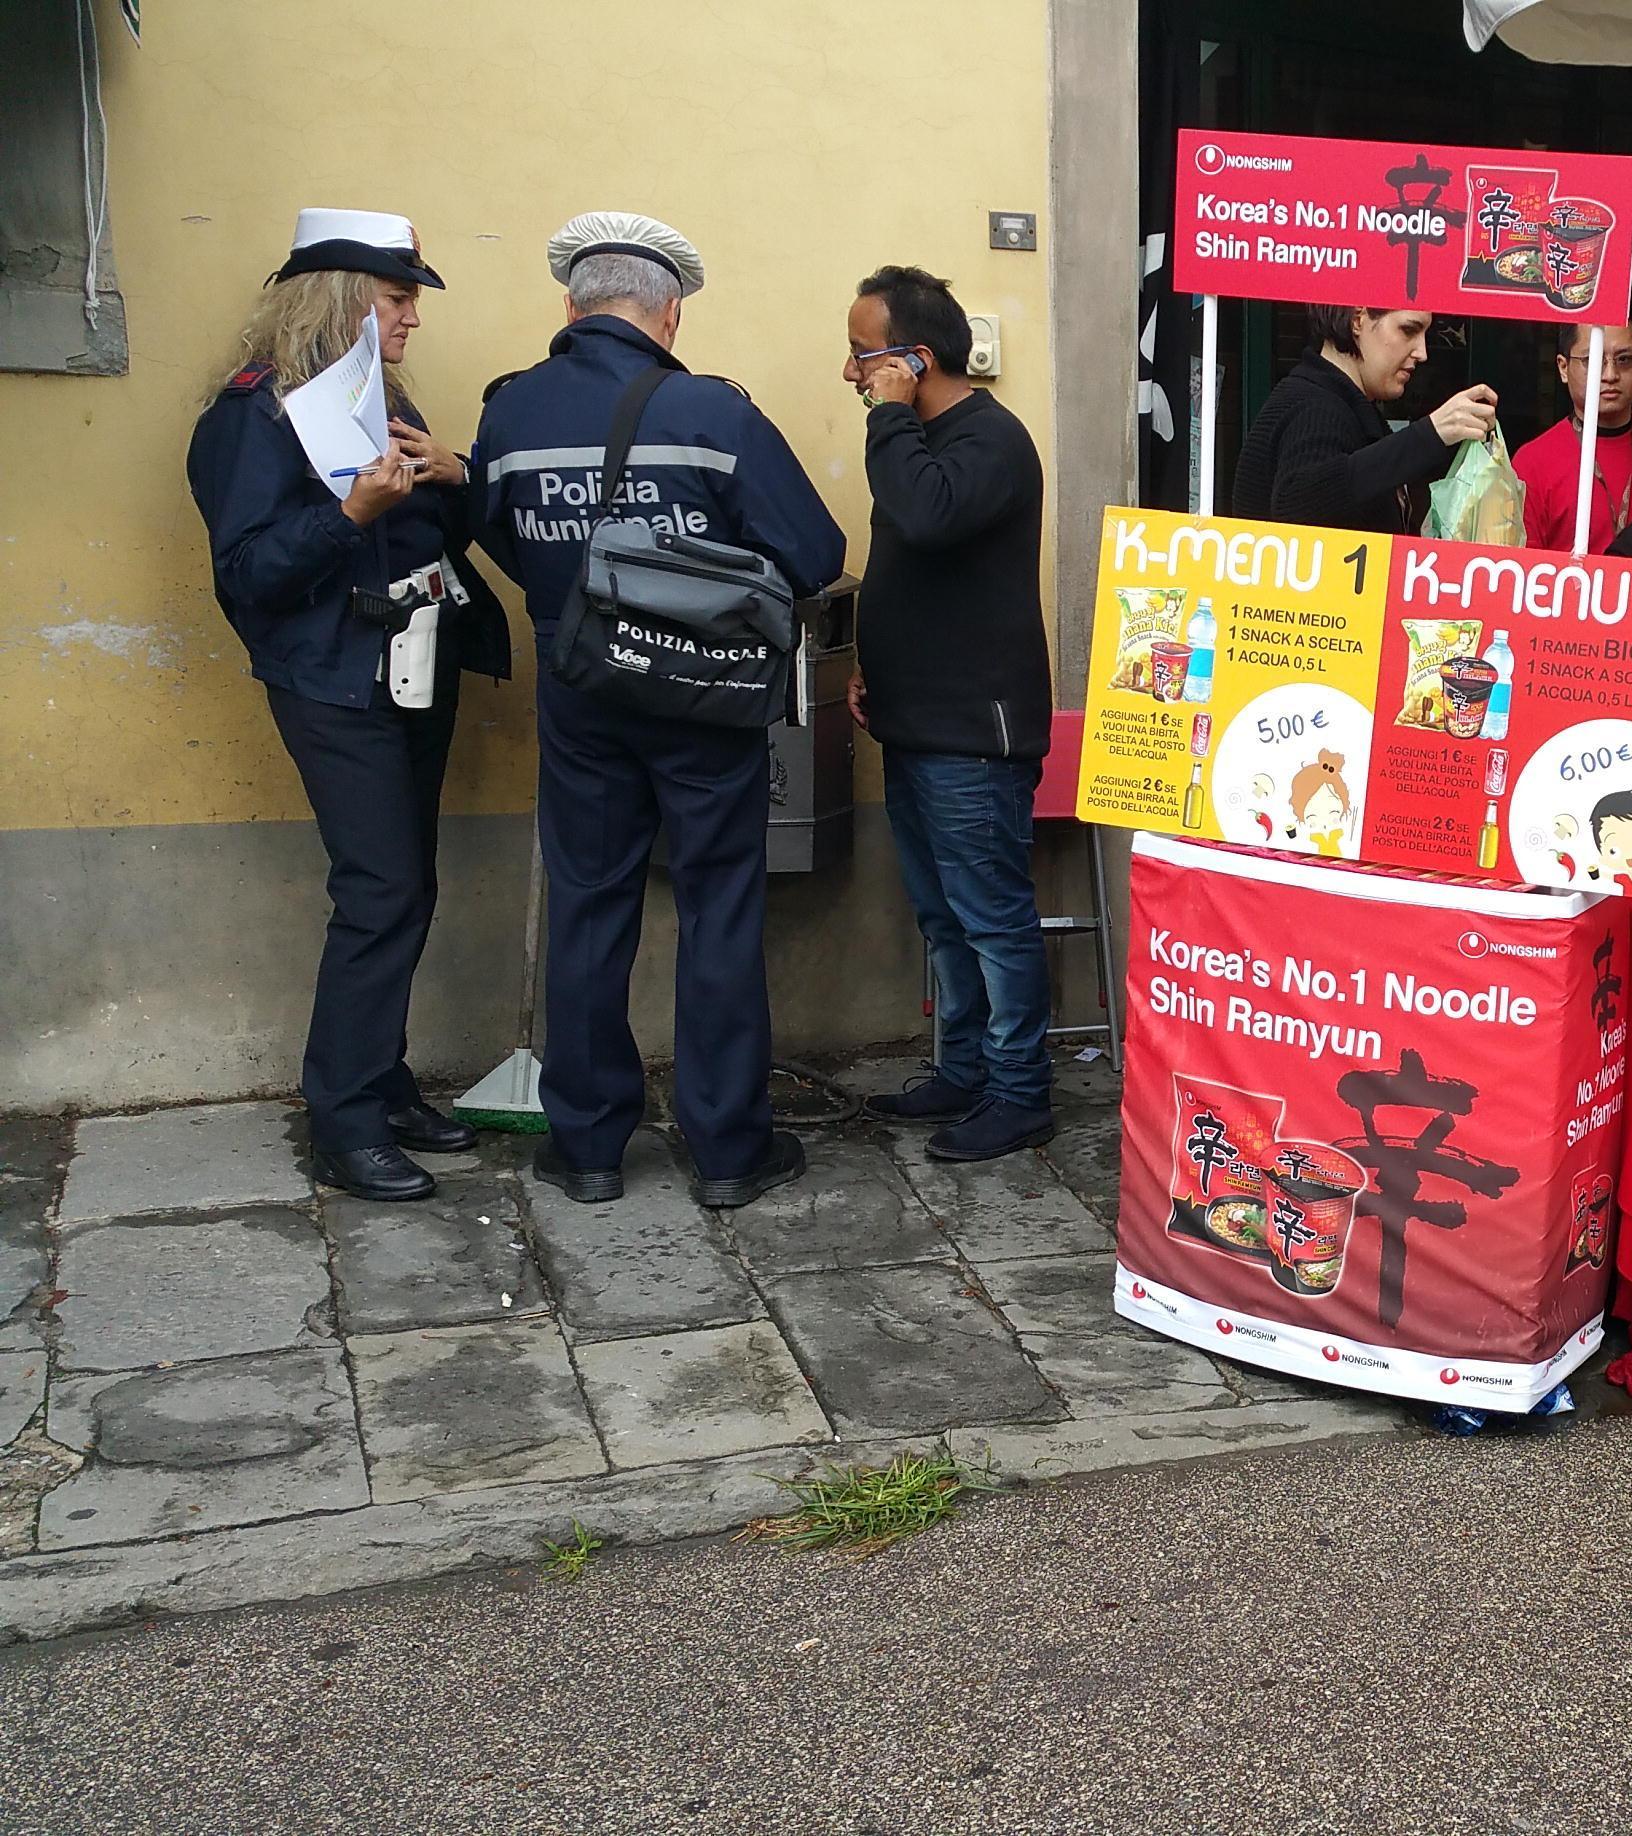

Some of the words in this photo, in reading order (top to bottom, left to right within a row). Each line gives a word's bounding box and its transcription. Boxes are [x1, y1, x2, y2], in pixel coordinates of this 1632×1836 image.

[1226, 153, 1292, 172] NONGSHIM
[1196, 193, 1289, 224] Korea's
[1295, 203, 1348, 231] No.1
[1357, 205, 1446, 237] Noodle
[1195, 235, 1250, 260] Shin
[1256, 237, 1358, 273] Ramyun
[539, 471, 659, 505] Polizia
[1114, 519, 1324, 592] K-MENU
[1343, 543, 1368, 595] 1
[1403, 550, 1631, 625] K-MENU
[1230, 604, 1238, 618] 1
[1243, 606, 1296, 625] RAMEN
[1298, 612, 1347, 630] MEDIO
[617, 621, 696, 654] POLIZIA
[1228, 626, 1237, 640] 1
[1241, 628, 1291, 646] SNACK
[1295, 634, 1305, 648] A
[1307, 634, 1364, 654] SCELTA
[1529, 638, 1538, 651] 1
[1542, 640, 1599, 657] RAMEN
[1226, 647, 1235, 661] 1
[1239, 650, 1291, 669] ACQUA
[1318, 659, 1327, 672] L
[1527, 660, 1536, 674] 1
[1539, 663, 1595, 681] SNACK
[1599, 667, 1610, 682] A
[1524, 682, 1533, 696] 1
[1537, 685, 1594, 703] ACQUA
[1624, 694, 1632, 707] L
[1101, 710, 1147, 722] AGGIUNGI
[1150, 712, 1157, 724] 1
[1161, 713, 1169, 726] €
[1171, 718, 1183, 728] SE
[1102, 721, 1125, 731] VUOI
[1127, 724, 1147, 734] UNA
[1149, 727, 1179, 739] BIBITA
[1094, 732, 1100, 740] A
[1103, 733, 1137, 745] SCELTA
[1139, 738, 1150, 747] AL
[1153, 740, 1185, 751] POSTO
[1109, 746, 1168, 760] DELL'ACQUA
[1387, 746, 1438, 760] AGGIUNGI
[1441, 748, 1448, 762] 1
[1452, 750, 1462, 762] €
[1464, 755, 1476, 765] SE
[1389, 758, 1413, 768] VUOI
[1416, 762, 1437, 772] UNA
[1440, 765, 1473, 776] BIBITA
[1094, 775, 1141, 789] AGGIUNGI
[1143, 778, 1151, 790] 2
[1154, 779, 1163, 792] €
[1164, 785, 1176, 793] SE
[1380, 769, 1387, 778] A
[1389, 770, 1426, 781] SCELTA
[1429, 775, 1442, 784] AL
[1444, 777, 1480, 789] POSTO
[1089, 786, 1112, 795] VUOI
[1114, 789, 1134, 799] UNA
[1136, 792, 1165, 804] BIRRA
[1167, 797, 1179, 806] AL
[1397, 783, 1460, 799] DELL'ACQUA
[1087, 797, 1119, 808] POSTO
[1121, 802, 1179, 817] DELL'ACQUA
[1380, 814, 1431, 828] AGGIUNGI
[1433, 816, 1442, 830] 2
[1445, 818, 1455, 831] €
[1457, 824, 1469, 833] SE
[1374, 826, 1400, 836] VUOI
[1401, 829, 1423, 839] UNA
[1426, 832, 1457, 843] BIRRA
[1459, 837, 1472, 846] AL
[1372, 836, 1406, 848] POSTO
[1409, 842, 1472, 858] DELL'ACQUA
[1489, 942, 1558, 959] NONGSHIM
[1149, 926, 1271, 989] Korea's
[1282, 957, 1367, 1006] No.1
[1384, 972, 1537, 1028] Noodle
[1150, 977, 1214, 1029] Shin
[1226, 1000, 1382, 1061] Ramyun
[1187, 1110, 1239, 1196] 辛
[1229, 1162, 1262, 1181] 라면
[1330, 1048, 1520, 1328] 辛
[1273, 1198, 1317, 1261] 辛
[1234, 1325, 1277, 1343] NONGSHIM
[1341, 1353, 1390, 1371] NONGSHIM
[1462, 1374, 1513, 1386] NONGSHIM
